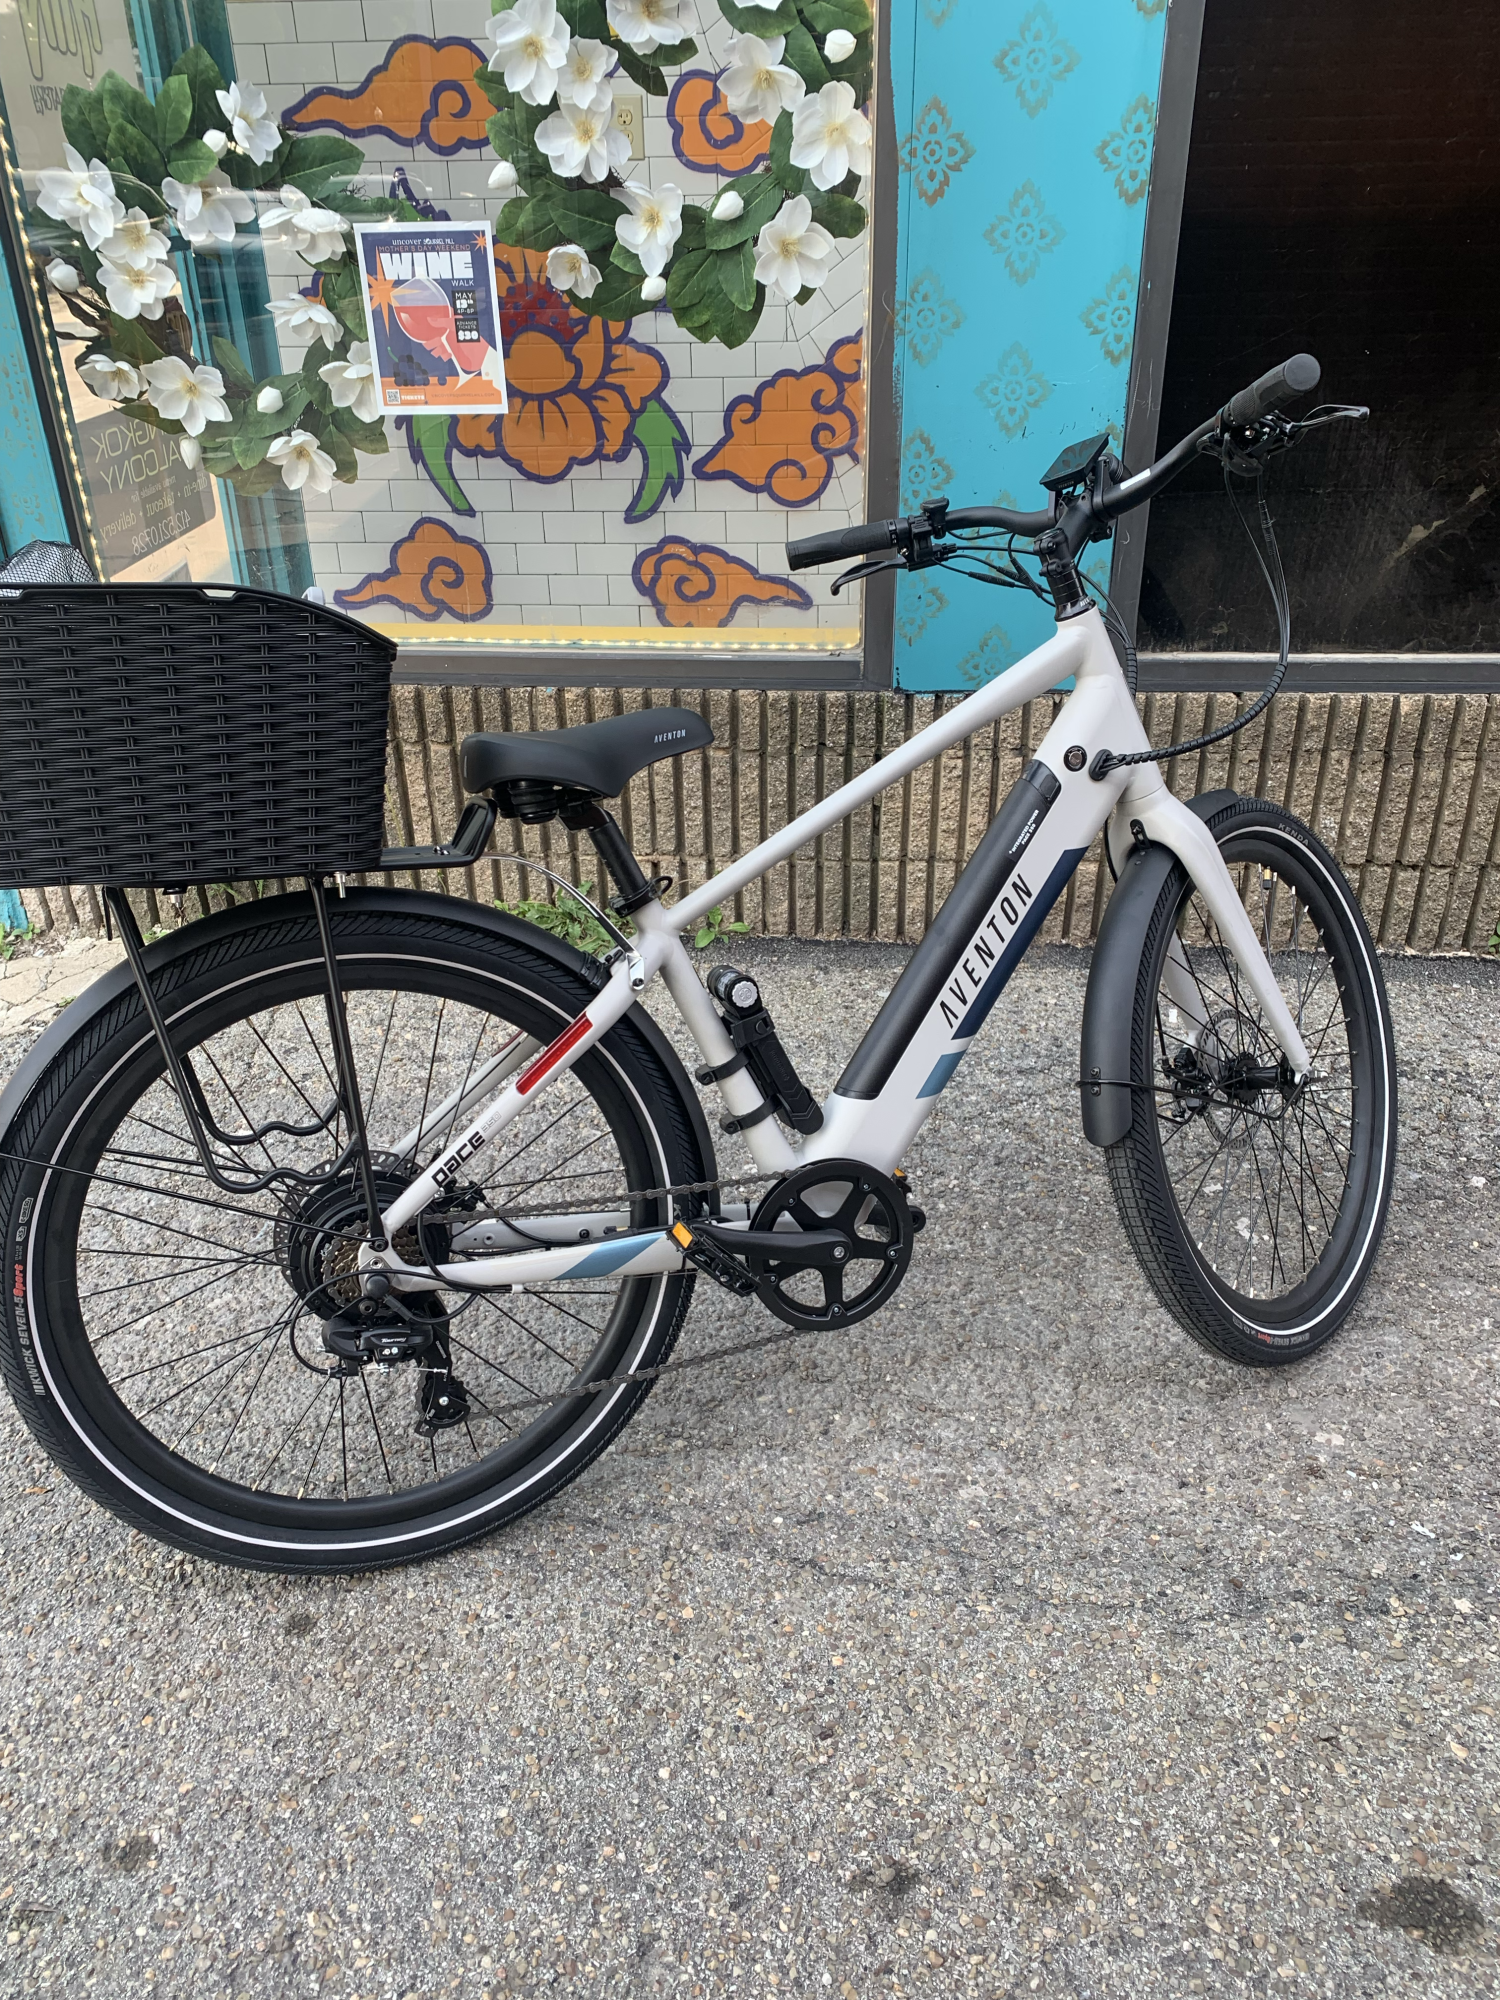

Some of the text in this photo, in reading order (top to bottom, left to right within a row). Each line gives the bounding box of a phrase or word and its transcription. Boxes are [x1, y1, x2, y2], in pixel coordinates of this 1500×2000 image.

[380, 251, 474, 280] WINE
[451, 279, 475, 287] WALK
[458, 330, 479, 341] $30
[654, 728, 687, 744] AVENTON
[1012, 809, 1039, 853] INTEGRATED POWER
[1021, 833, 1031, 845] PACE
[1278, 822, 1309, 846] KENDA
[939, 873, 1033, 1029] AVENTON
[481, 1110, 502, 1133] 350
[13, 1263, 27, 1297] Sport
[14, 1295, 30, 1346] SEVEN-5
[24, 1349, 45, 1389] KWICK
